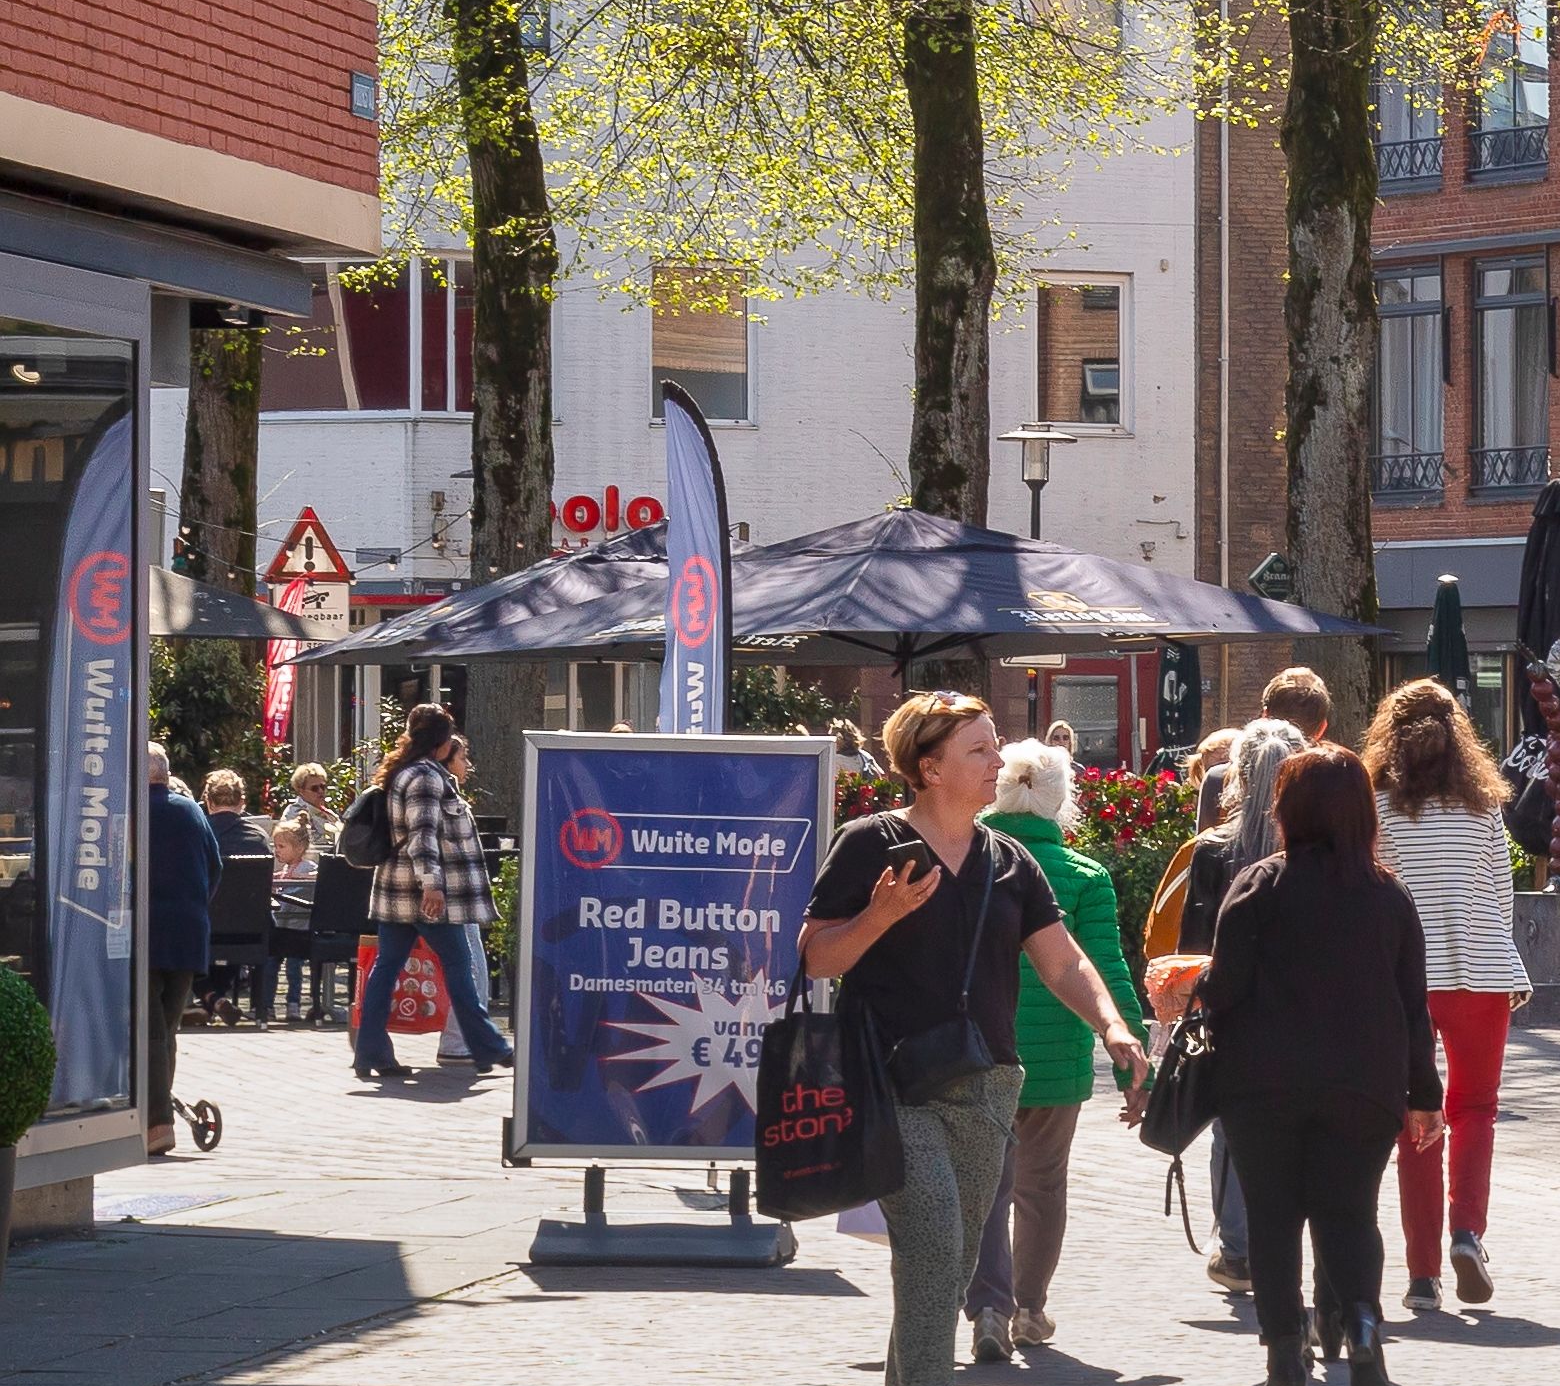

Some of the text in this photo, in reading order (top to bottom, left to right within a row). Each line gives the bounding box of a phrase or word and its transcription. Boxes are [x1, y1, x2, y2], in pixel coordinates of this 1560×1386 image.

[550, 485, 664, 532] olo
[686, 662, 704, 734] Wui
[78, 659, 113, 892] Wuite Mode
[632, 829, 709, 854] Wuite
[717, 832, 786, 857] Mode
[579, 897, 780, 932] Red Button
[627, 937, 729, 970] Jeans
[570, 974, 696, 993] Damesmaten
[702, 978, 725, 994] 34
[763, 979, 786, 996] 46
[714, 1019, 766, 1037] vana
[691, 1037, 710, 1066] €
[783, 1083, 845, 1115] the
